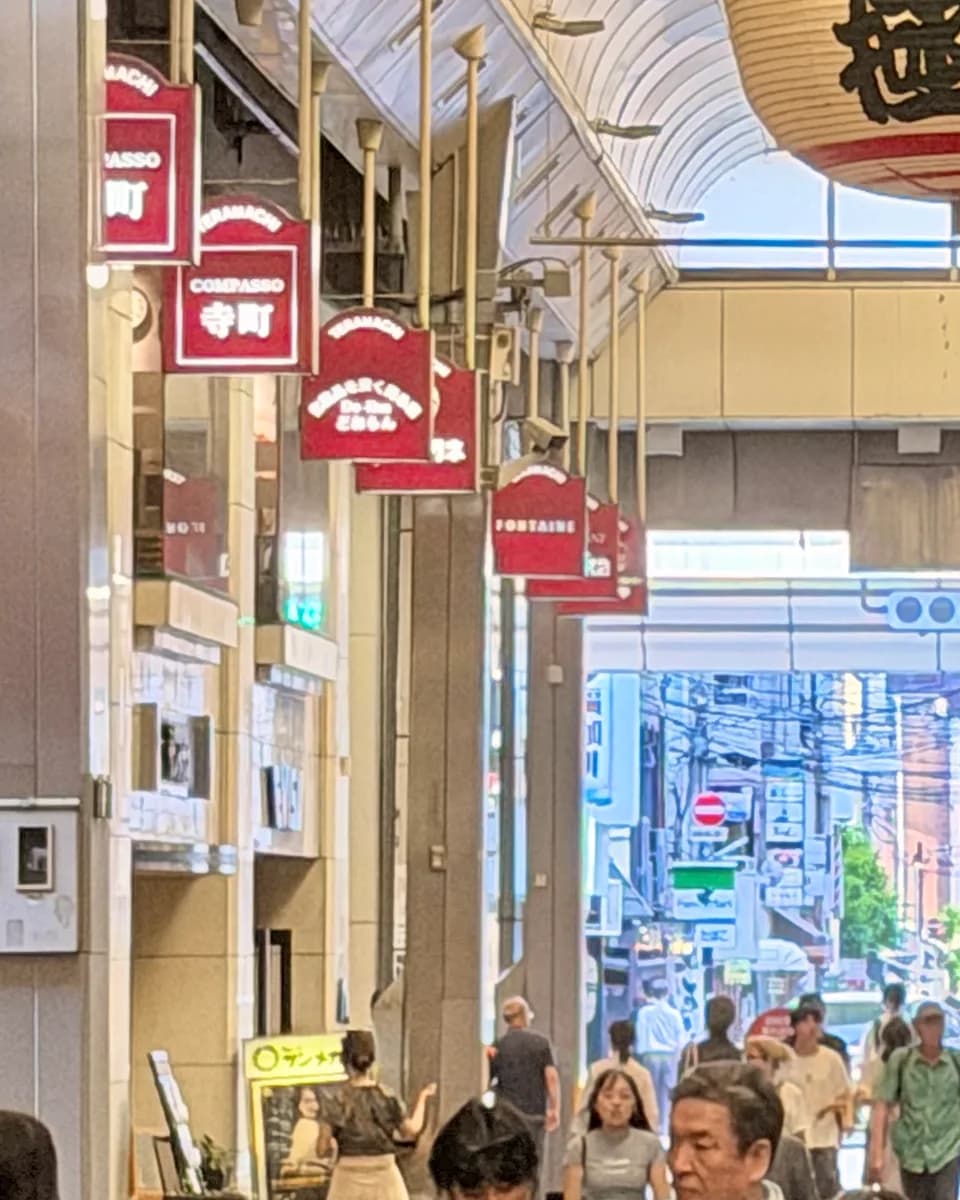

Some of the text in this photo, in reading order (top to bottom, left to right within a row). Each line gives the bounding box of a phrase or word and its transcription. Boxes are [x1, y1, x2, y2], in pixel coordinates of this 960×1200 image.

[190, 278, 285, 294] COMPASSO
[200, 302, 274, 339] 寺町
[495, 519, 576, 534] FONTAINE
